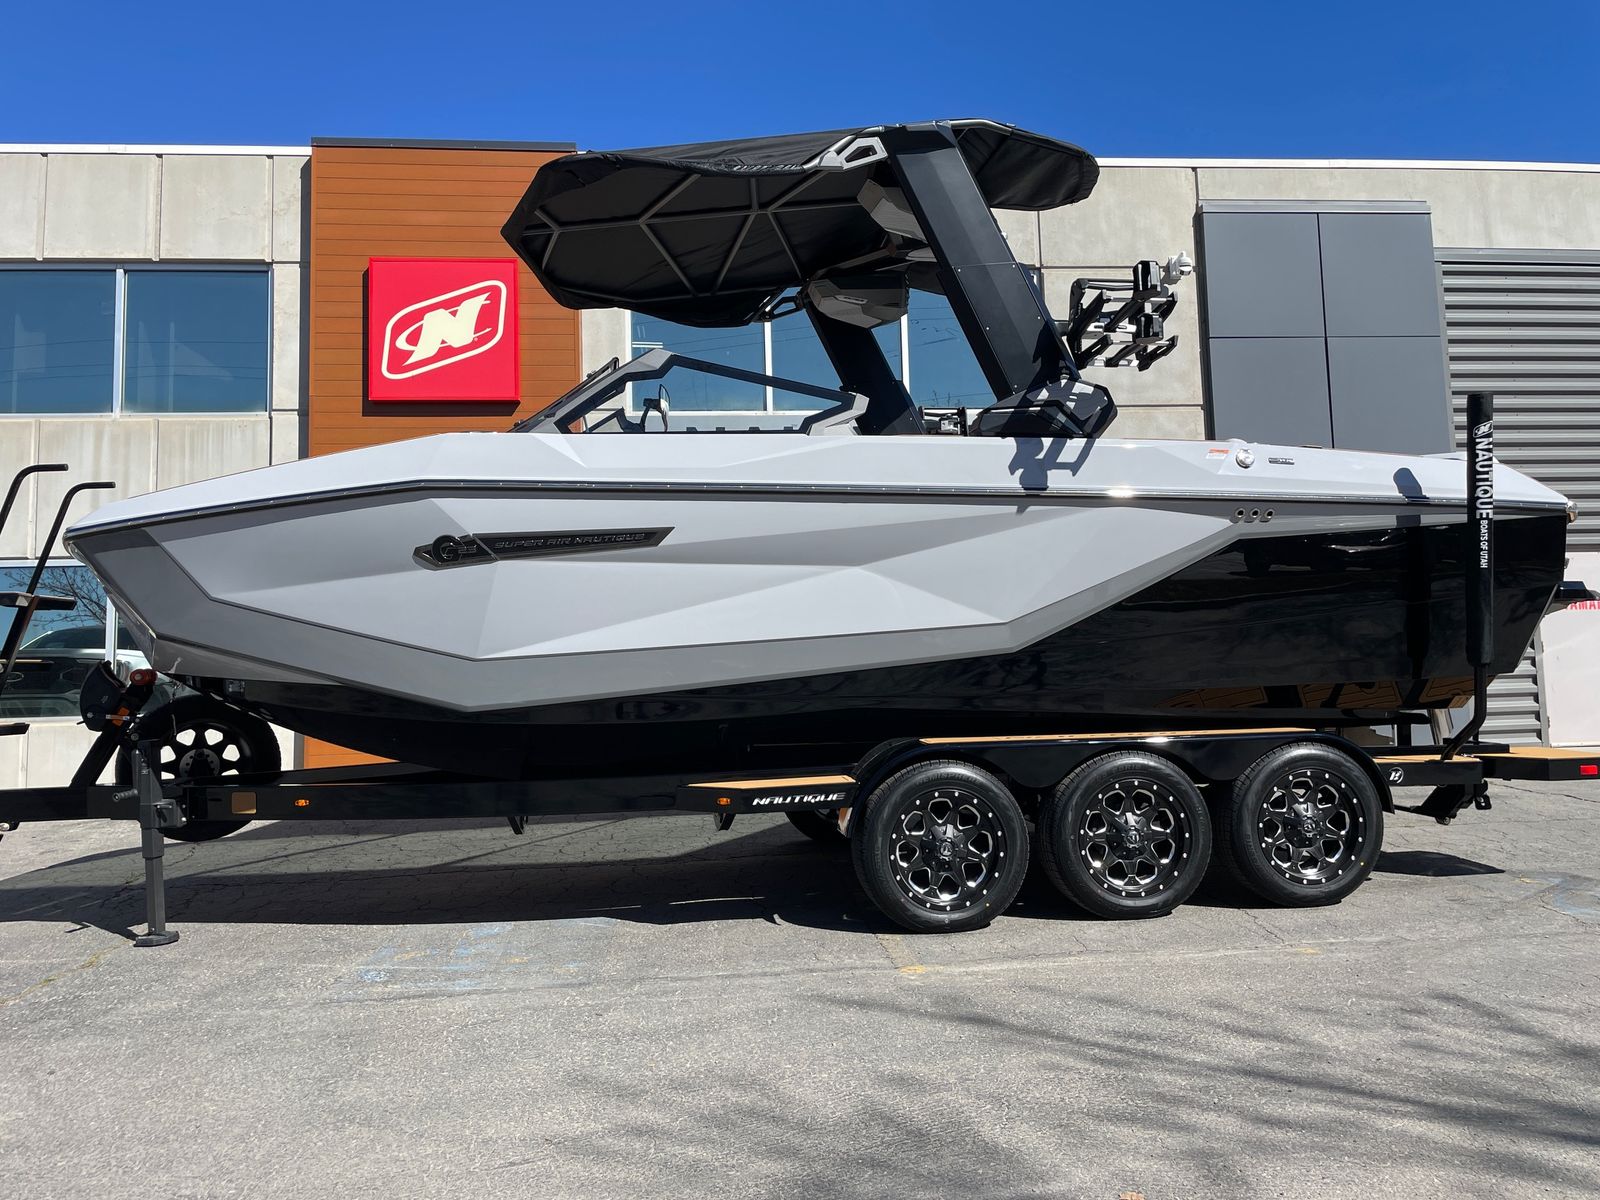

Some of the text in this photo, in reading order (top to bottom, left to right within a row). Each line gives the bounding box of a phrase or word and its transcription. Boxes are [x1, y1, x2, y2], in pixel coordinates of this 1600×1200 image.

[1475, 437, 1493, 568] NAUTIQUE BOATS OF UTAH
[494, 533, 645, 549] SUPER AIR NAUTIQUE
[1569, 600, 1600, 610] AMA
[752, 792, 846, 806] NAUTIQUE
